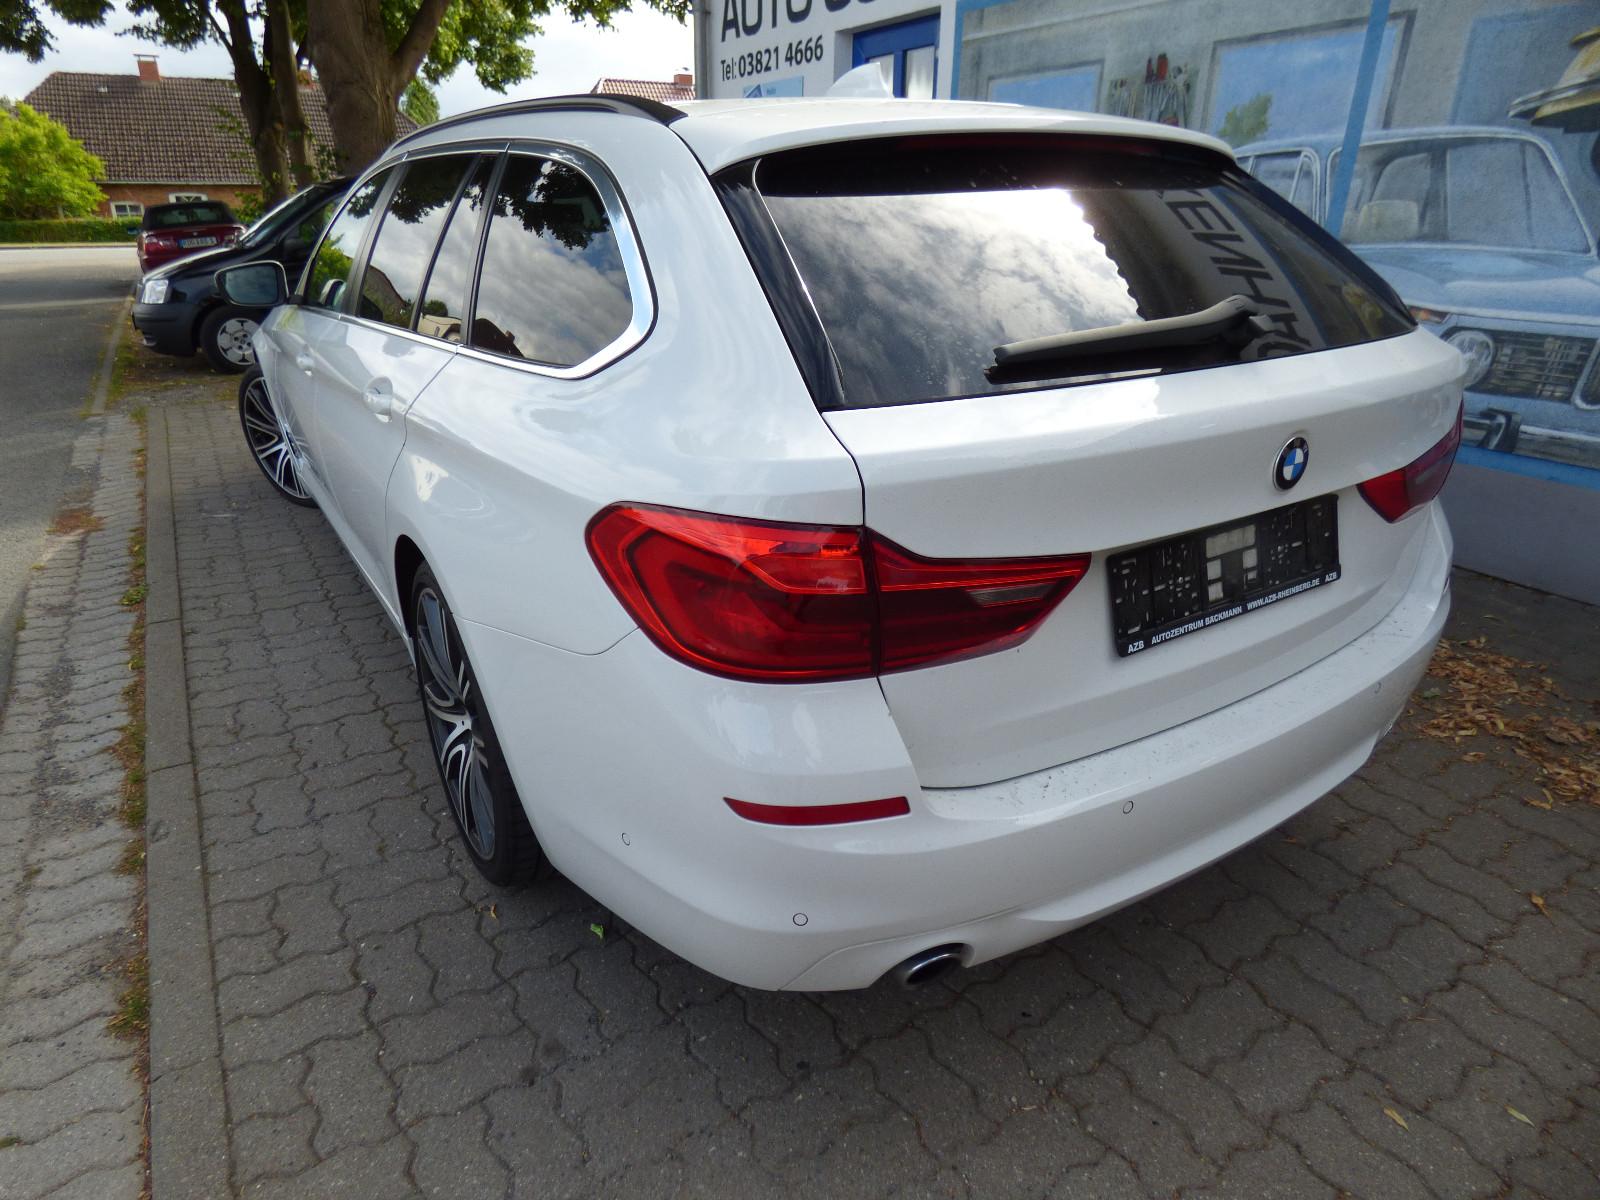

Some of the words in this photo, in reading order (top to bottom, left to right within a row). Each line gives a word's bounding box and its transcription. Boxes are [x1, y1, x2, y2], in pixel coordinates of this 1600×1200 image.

[720, 56, 737, 81] Tel:
[738, 46, 779, 77] 03821
[784, 35, 824, 66] 4666
[1127, 640, 1145, 654] AZB
[1151, 619, 1204, 644] AUTOZENTRUM
[1324, 571, 1337, 583] AZB
